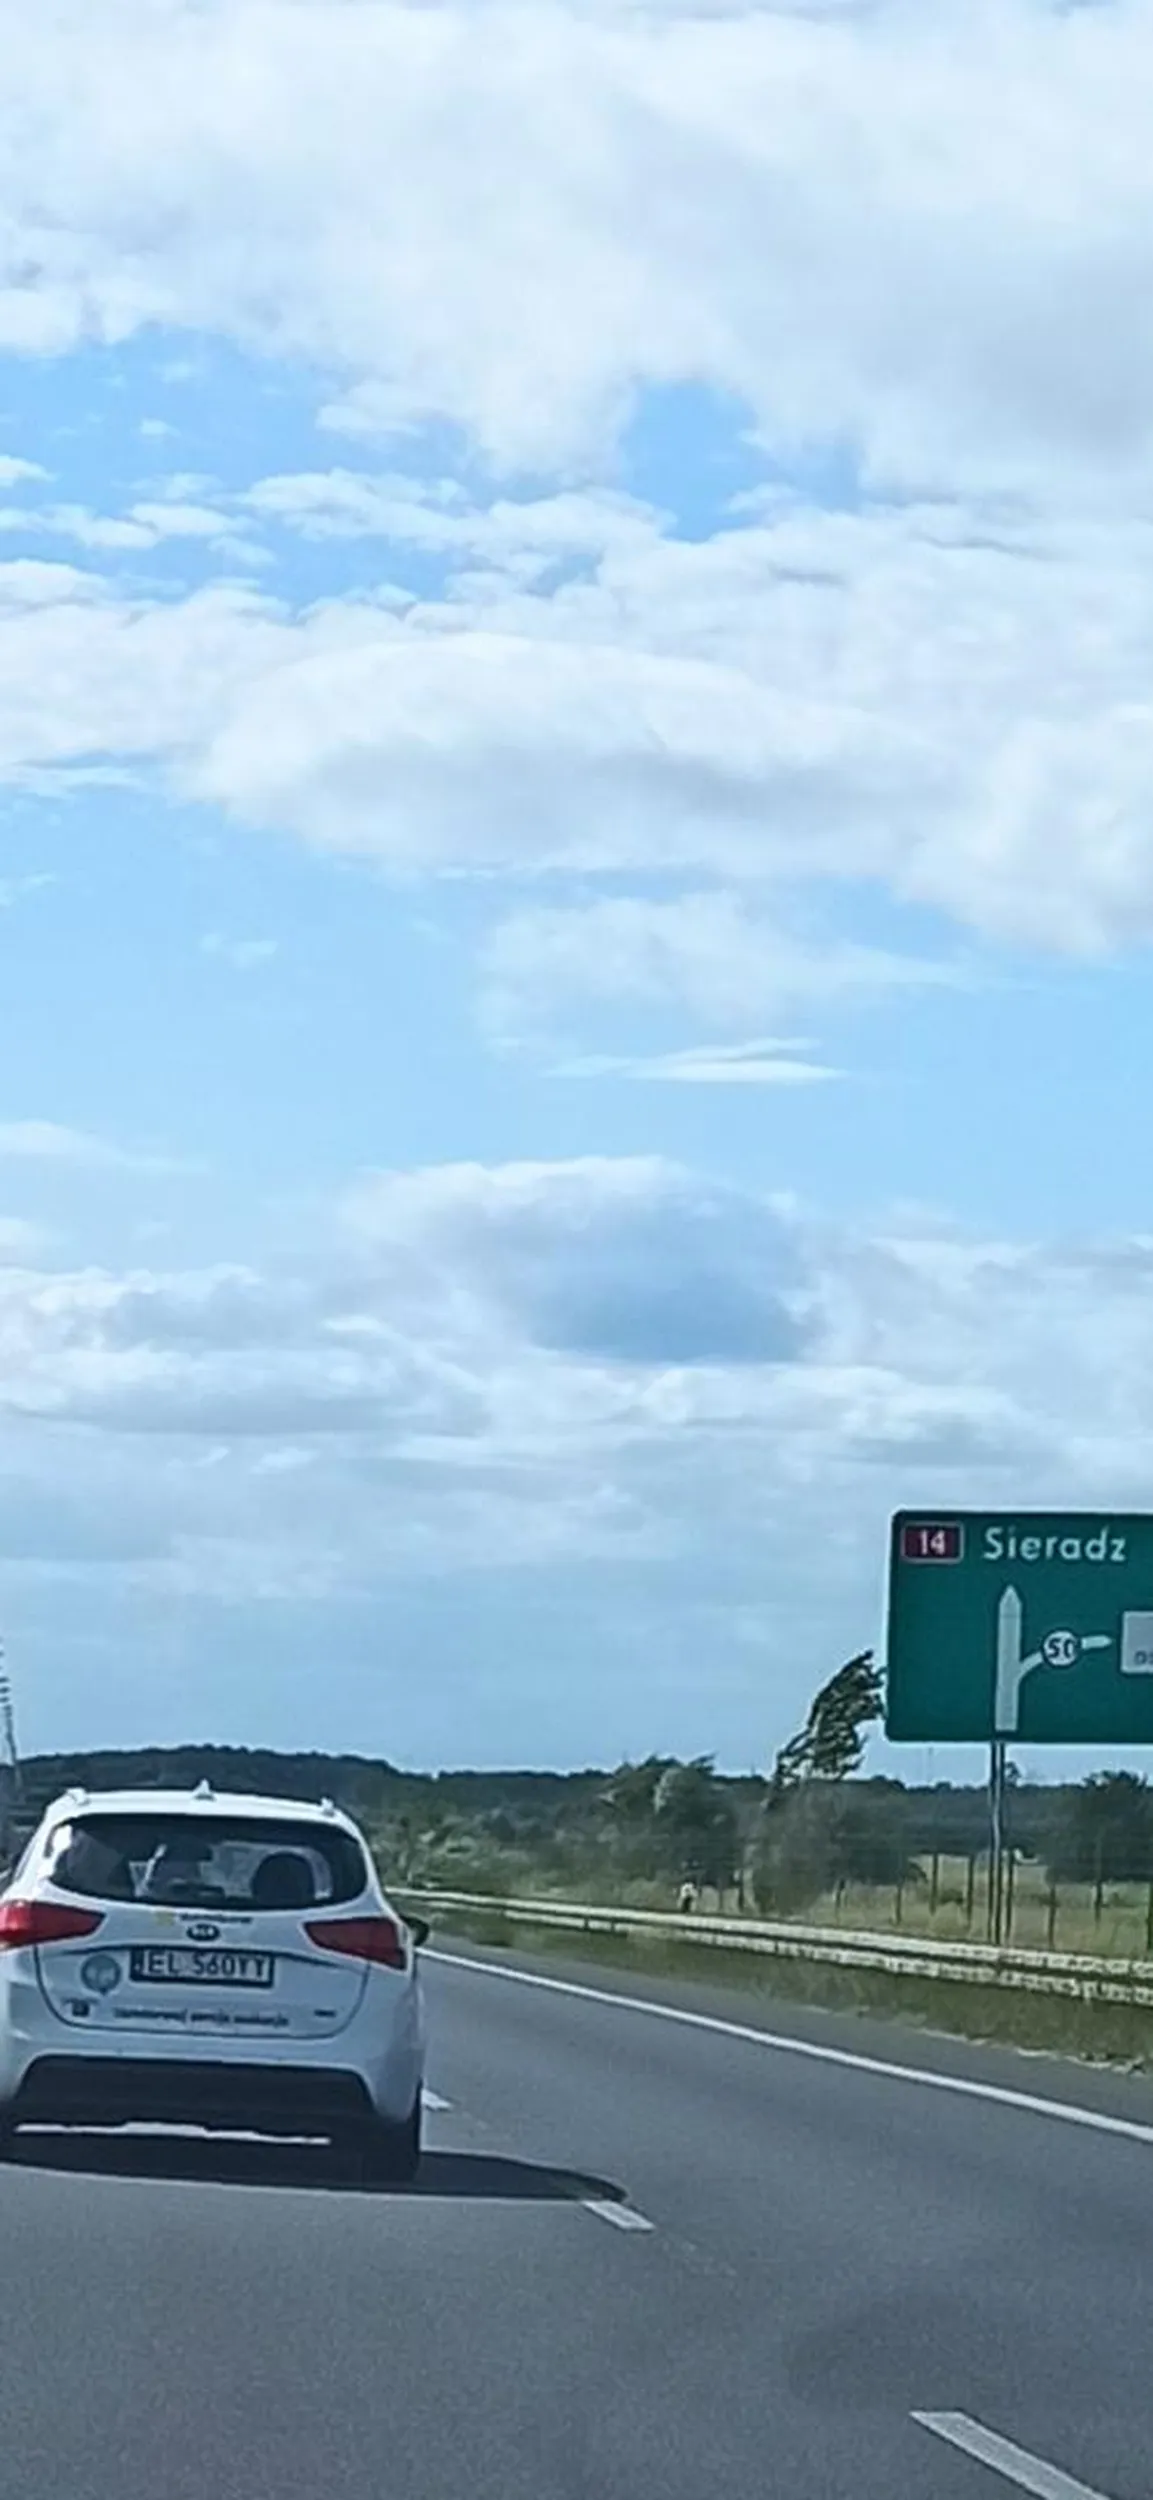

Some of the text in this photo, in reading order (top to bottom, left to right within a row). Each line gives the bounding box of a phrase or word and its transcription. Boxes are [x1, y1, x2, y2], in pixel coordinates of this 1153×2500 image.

[920, 1526, 1126, 1561] 14 Sieradz
[149, 1951, 180, 1974] EL
